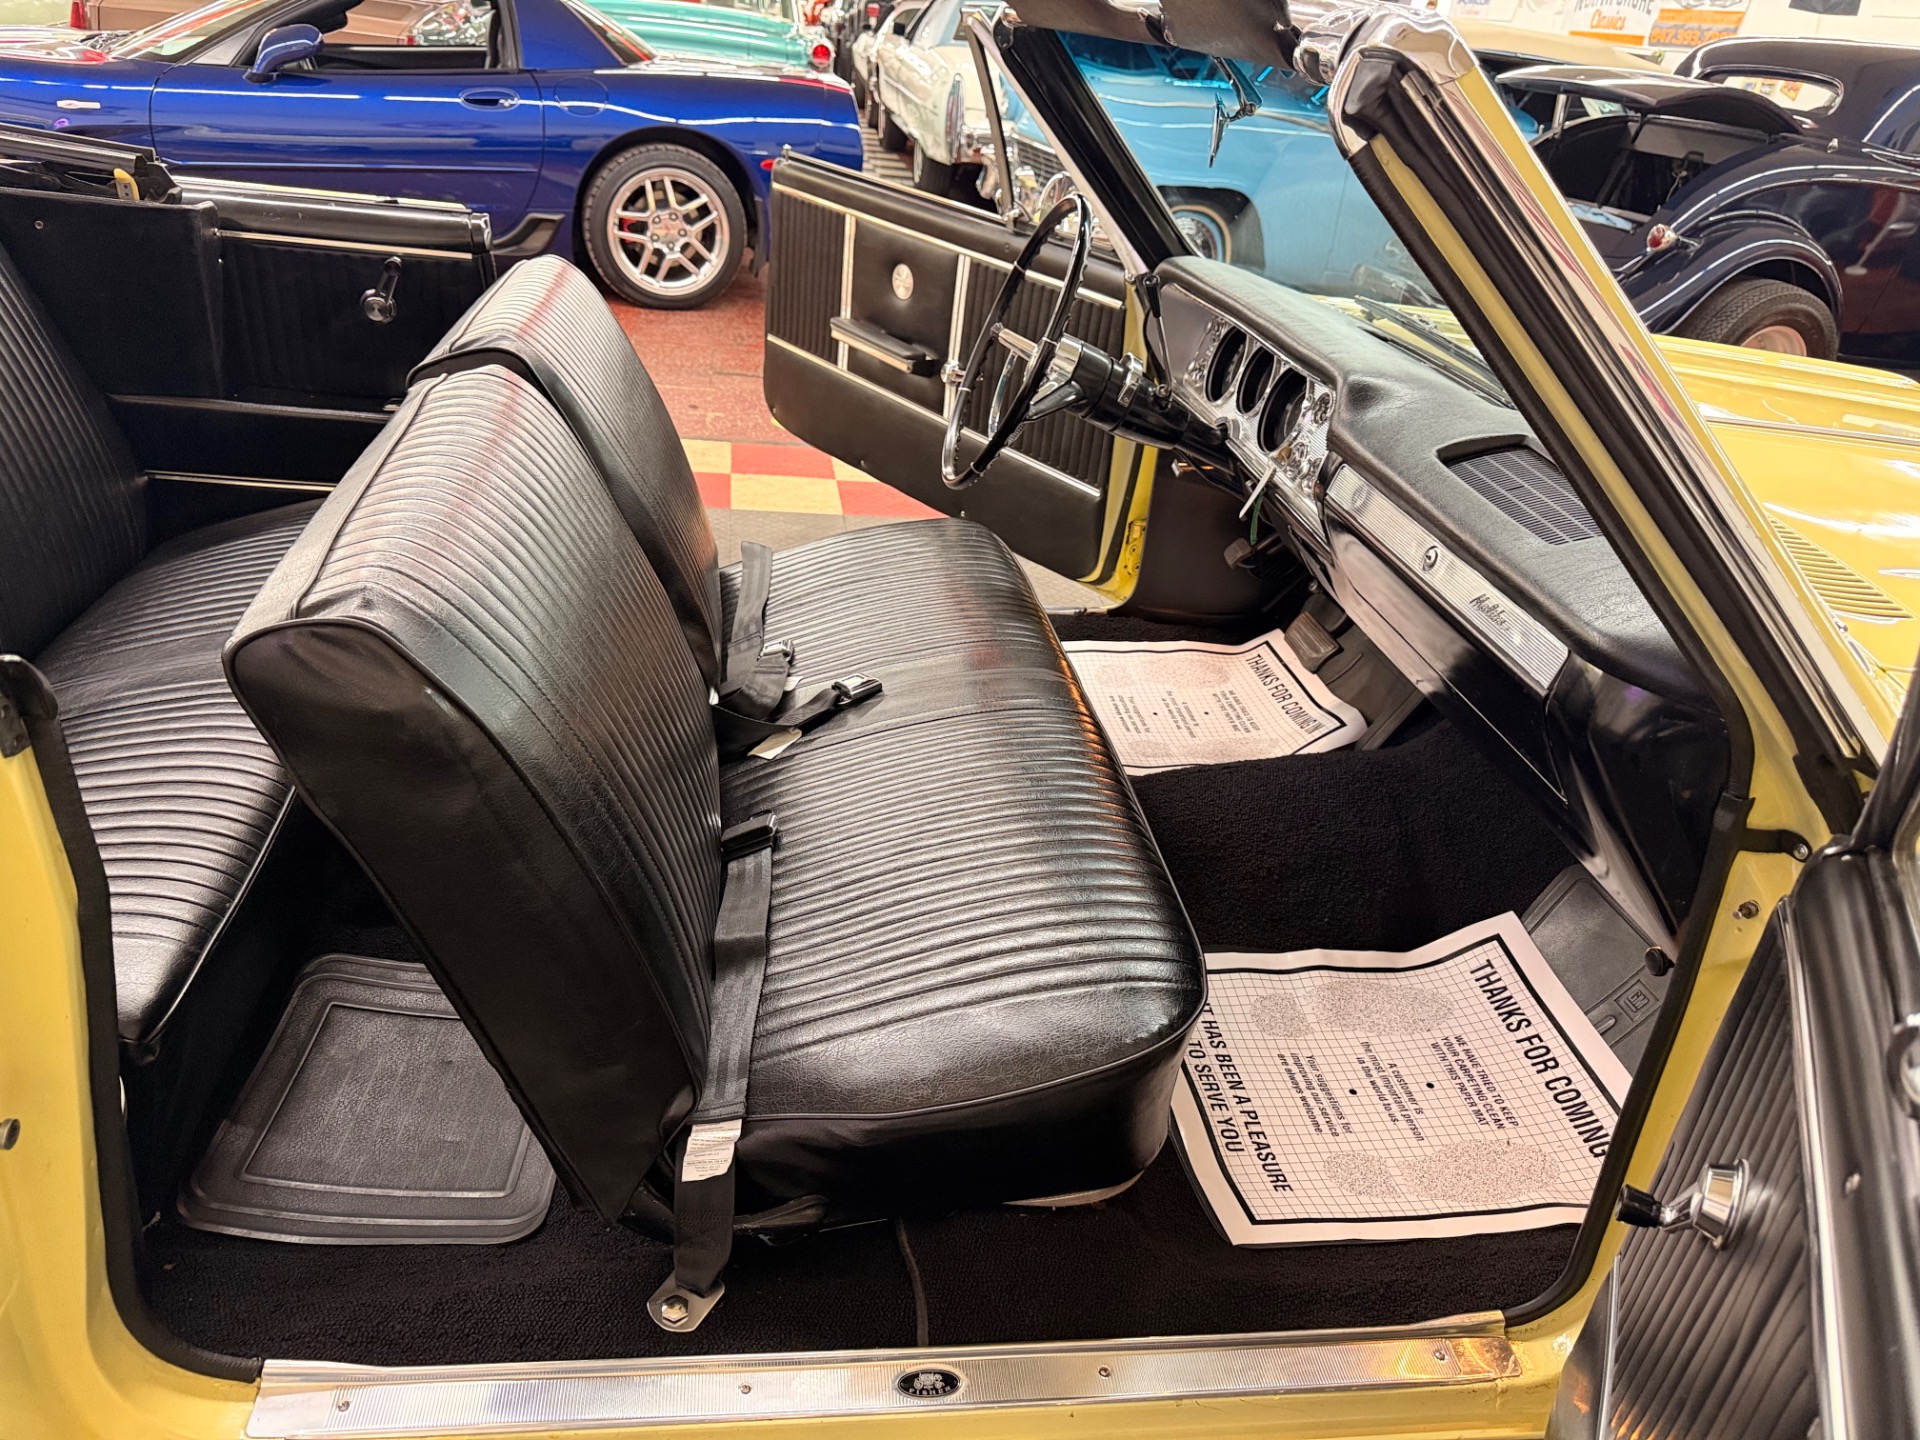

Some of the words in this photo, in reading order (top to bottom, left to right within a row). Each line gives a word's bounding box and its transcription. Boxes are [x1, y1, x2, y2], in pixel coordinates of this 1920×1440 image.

[1246, 653, 1279, 686] THANKS
[1267, 683, 1293, 704] FOR
[1281, 701, 1317, 730] COMING
[1627, 989, 1649, 1010] GM
[1188, 1040, 1206, 1059] TO
[1201, 1020, 1226, 1049] HAS
[1470, 959, 1532, 1033] THANKS
[1516, 1034, 1560, 1074] FOR
[1545, 1075, 1610, 1158] COMING
[1194, 1064, 1230, 1112] SERVE
[1215, 1053, 1246, 1091] BEEN
[1233, 1095, 1251, 1105] A
[1277, 1053, 1289, 1066] are
[1285, 1068, 1303, 1094] always
[1290, 1053, 1316, 1091] improving
[1311, 1092, 1324, 1106] our
[1319, 1107, 1339, 1137] service
[1306, 1054, 1319, 1072] Your
[1315, 1073, 1345, 1120] suggestions
[1341, 1122, 1352, 1133] for
[1361, 1041, 1372, 1053] the
[1369, 1055, 1386, 1073] most
[1380, 1075, 1409, 1112] important
[1401, 1113, 1424, 1141] person
[1361, 1065, 1373, 1078] the
[1369, 1080, 1389, 1101] world
[1383, 1103, 1392, 1111] to
[1388, 1113, 1399, 1125] us.
[1392, 1070, 1419, 1106] customer
[1414, 1107, 1424, 1115] is
[1431, 1042, 1449, 1061] WITH
[1444, 1063, 1460, 1080] THIS
[1455, 1082, 1477, 1108] PAPER
[1472, 1108, 1490, 1125] MAT
[1441, 1036, 1459, 1057] YOUR
[1455, 1059, 1488, 1101] CARPETING
[1483, 1103, 1506, 1129] CLEAN
[1454, 1035, 1468, 1047] WE
[1462, 1048, 1481, 1068] HAVE
[1476, 1069, 1496, 1092] TRIED
[1492, 1093, 1504, 1104] TO
[1499, 1106, 1519, 1127] KEEP
[1217, 1117, 1245, 1153] YOU
[1240, 1109, 1293, 1193] PLEASURE
